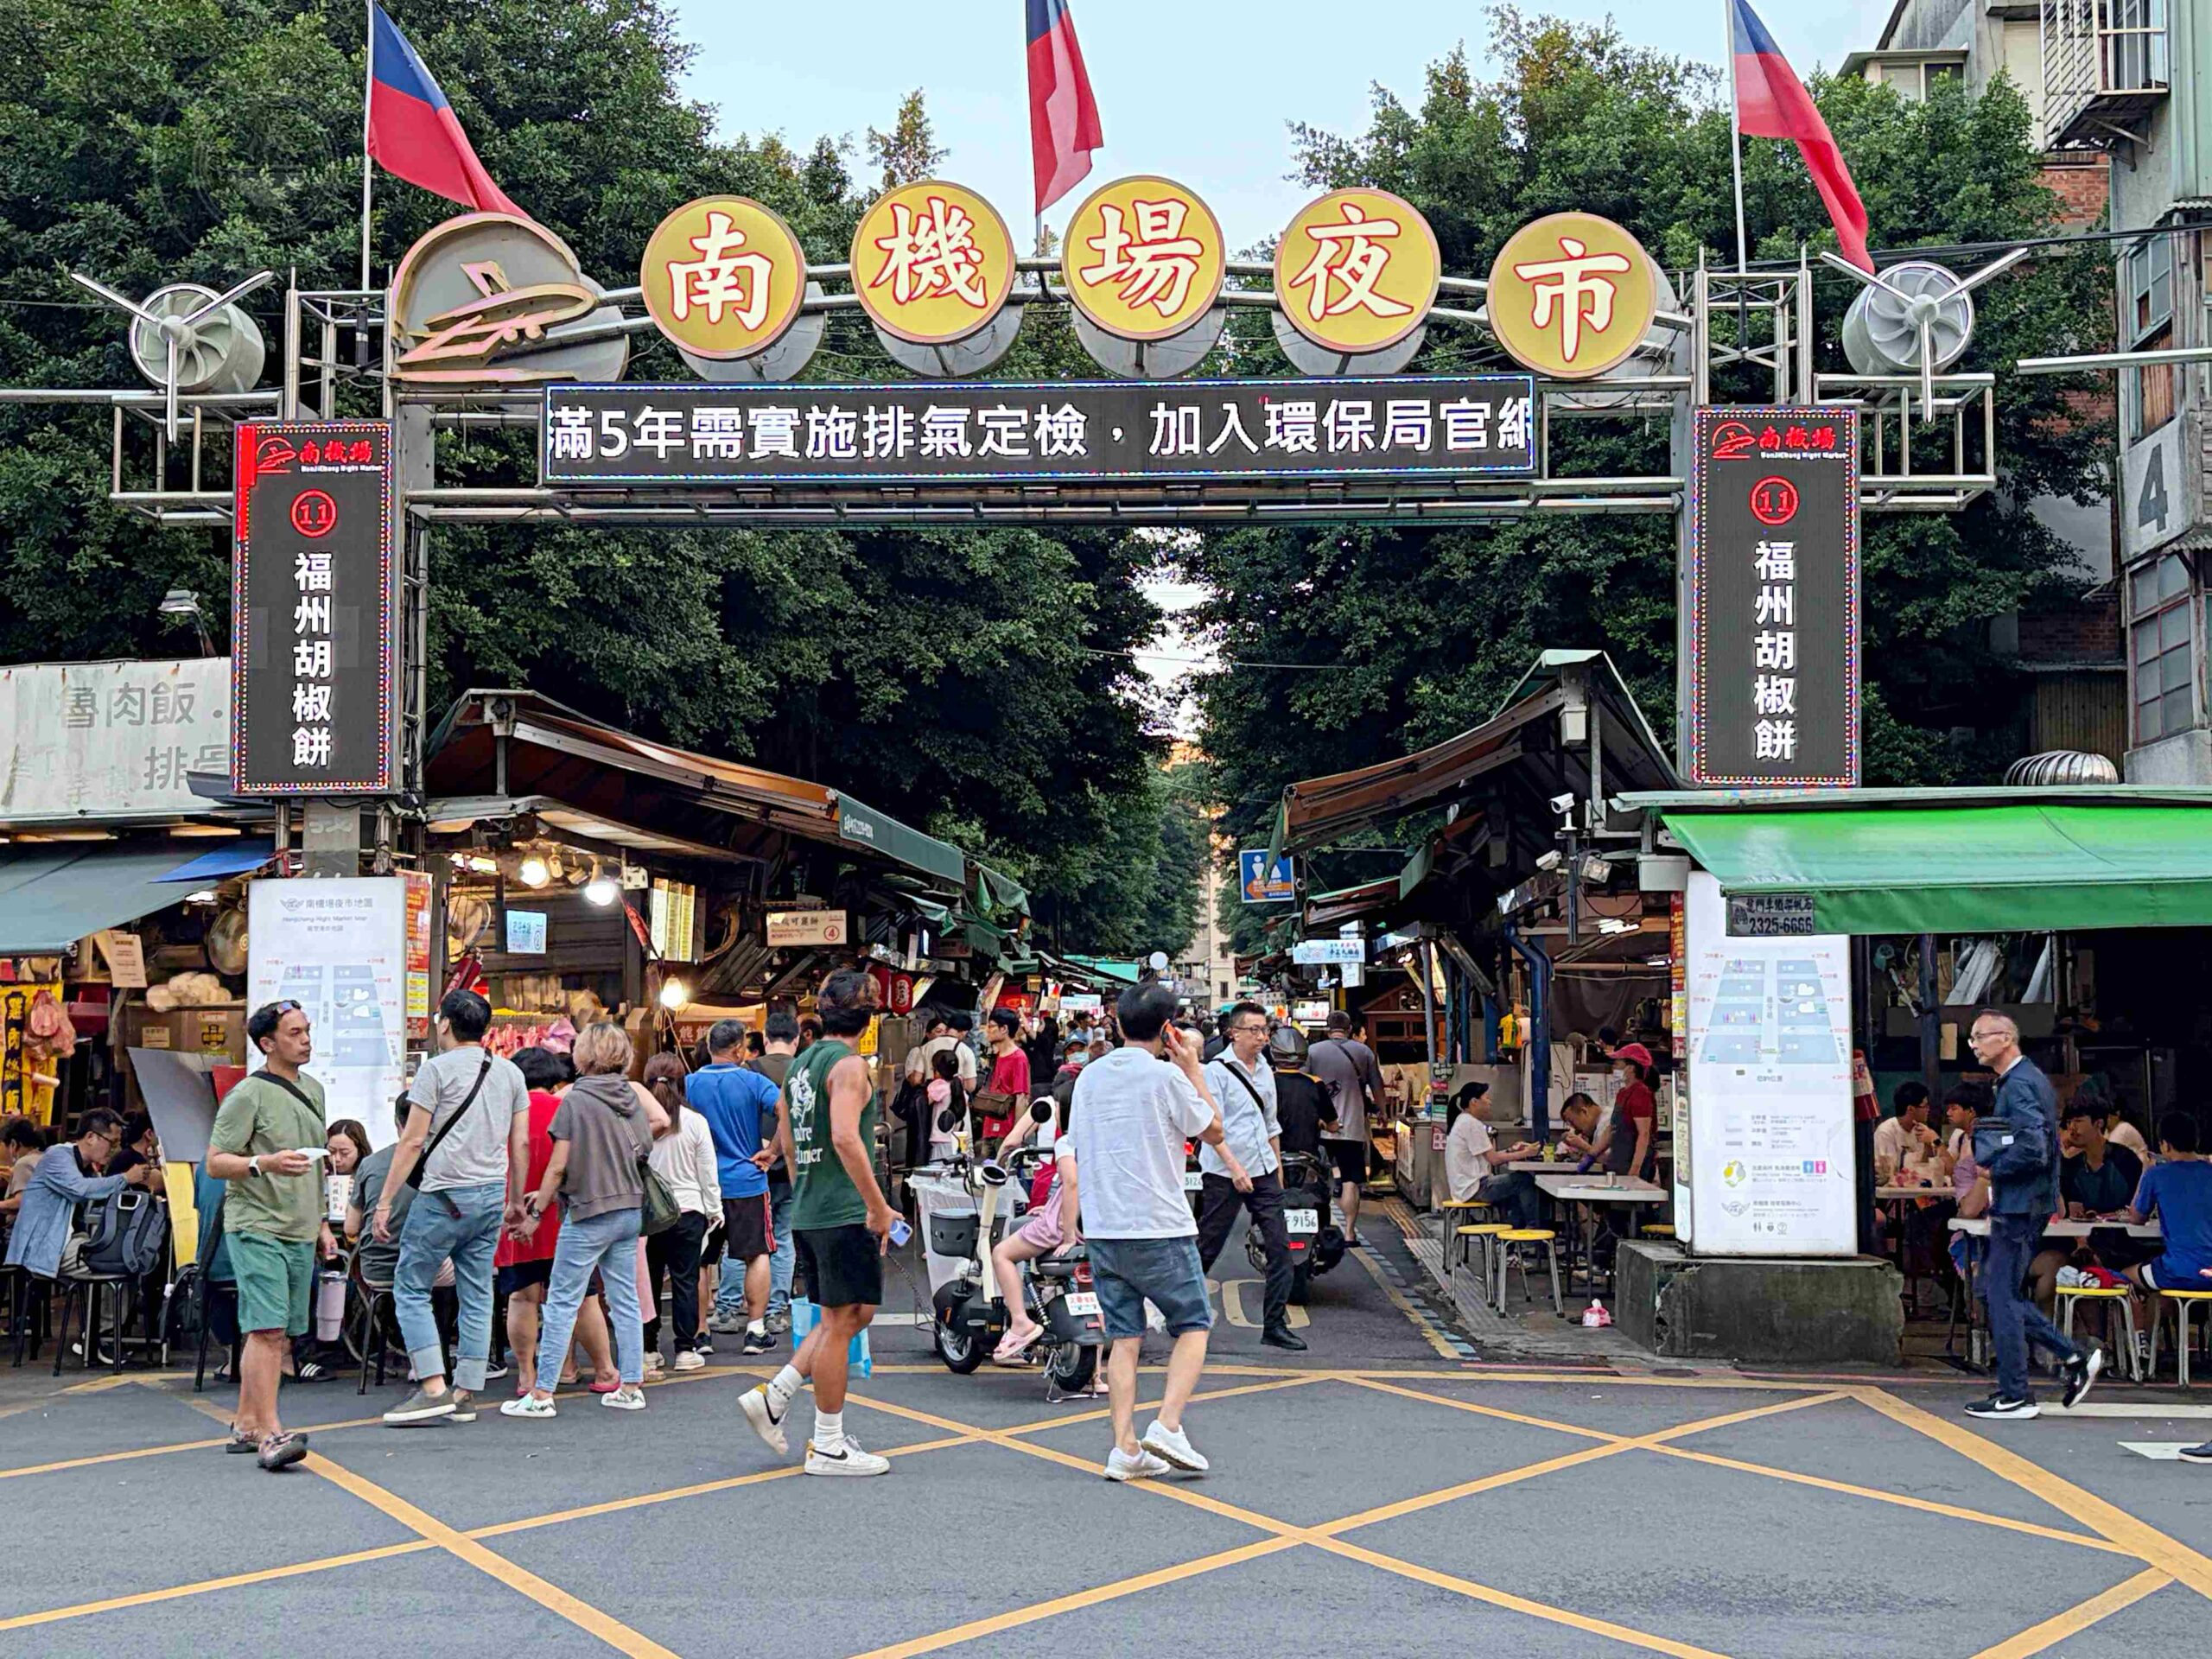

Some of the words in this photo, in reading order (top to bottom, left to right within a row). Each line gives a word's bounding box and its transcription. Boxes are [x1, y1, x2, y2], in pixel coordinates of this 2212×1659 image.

[667, 199, 1631, 363] 南機場夜市
[299, 440, 372, 464] 南機場
[1758, 426, 1836, 450] 南機場
[2138, 443, 2168, 533] 4
[292, 552, 334, 767] 福州胡椒餅
[1753, 540, 1796, 760] 福州胡椒餅
[1749, 917, 1812, 934] 2325-6666
